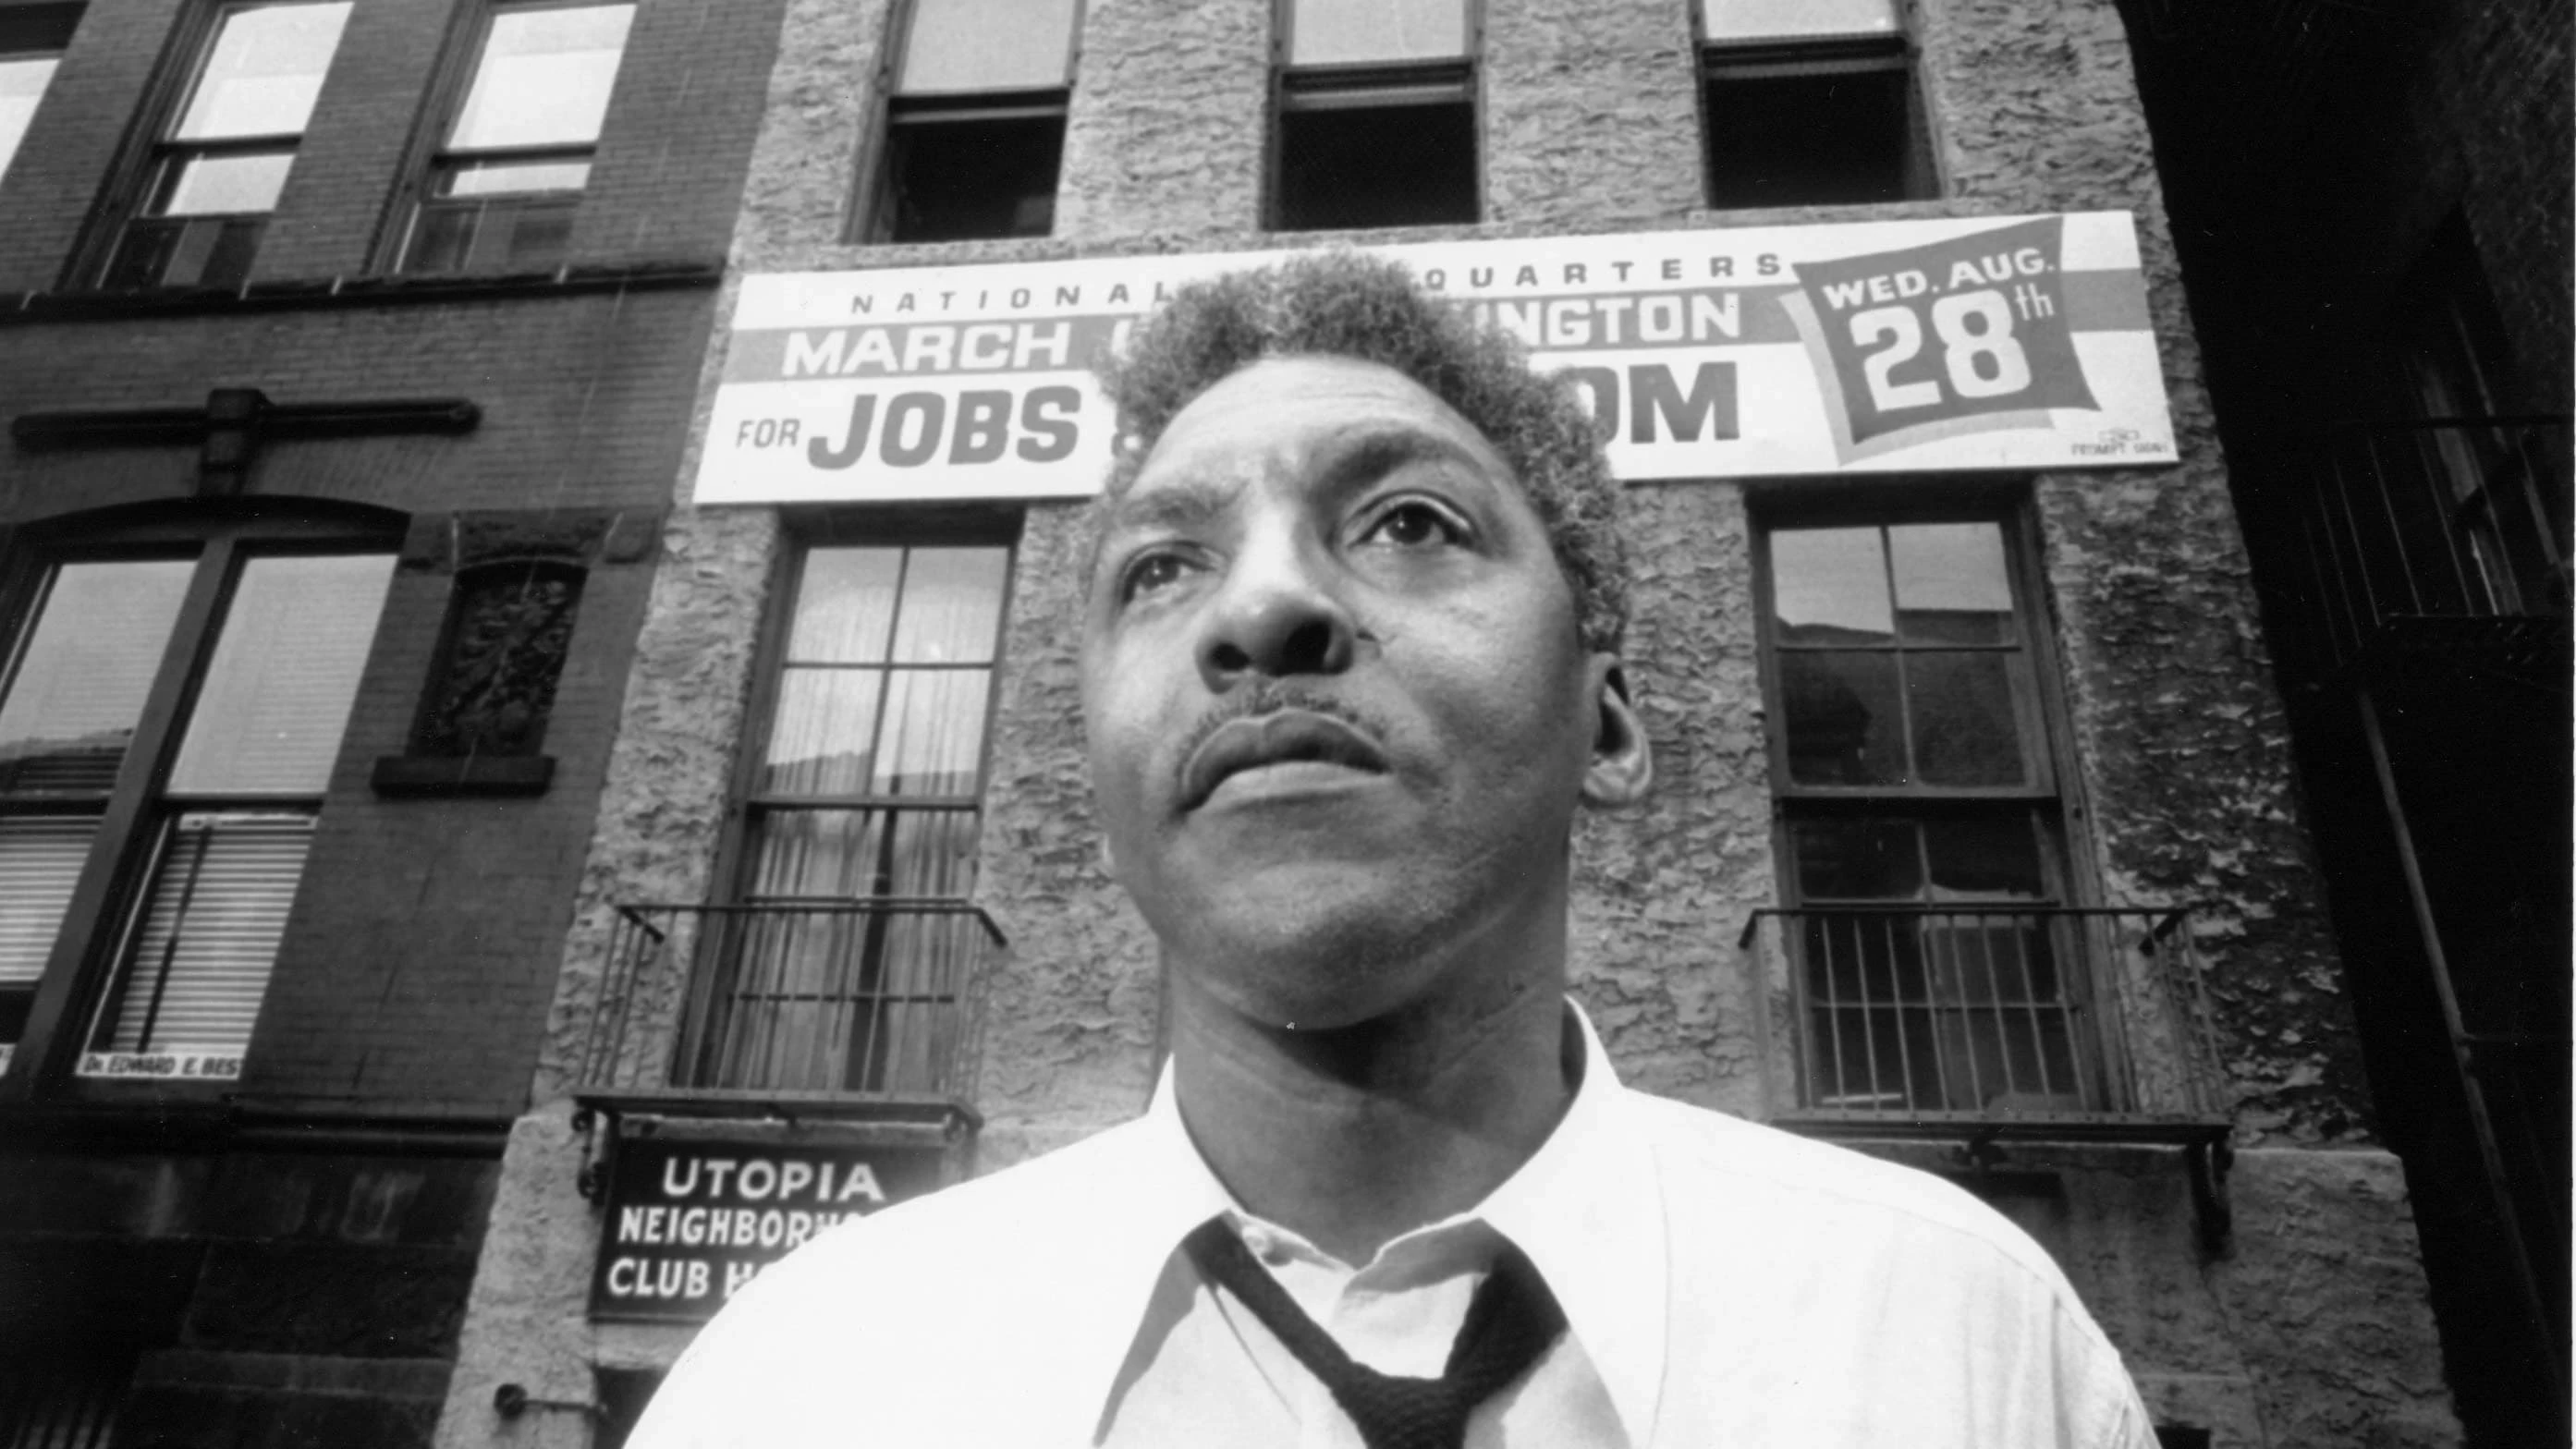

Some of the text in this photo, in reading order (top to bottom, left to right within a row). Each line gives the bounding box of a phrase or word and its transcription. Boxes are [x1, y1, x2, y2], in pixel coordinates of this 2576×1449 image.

[851, 280, 1173, 313] NATIONAL
[1824, 247, 2057, 310] WED. AUG.
[782, 322, 1070, 377] MARCH
[1449, 292, 1740, 347] INGTON
[736, 418, 801, 449] FOR
[807, 384, 1082, 470] JOBS
[201, 1057, 240, 1078] BES
[662, 1157, 885, 1201] UTOPIA
[618, 1205, 861, 1248] NEIGHBOR
[607, 1256, 712, 1299] CLUB
